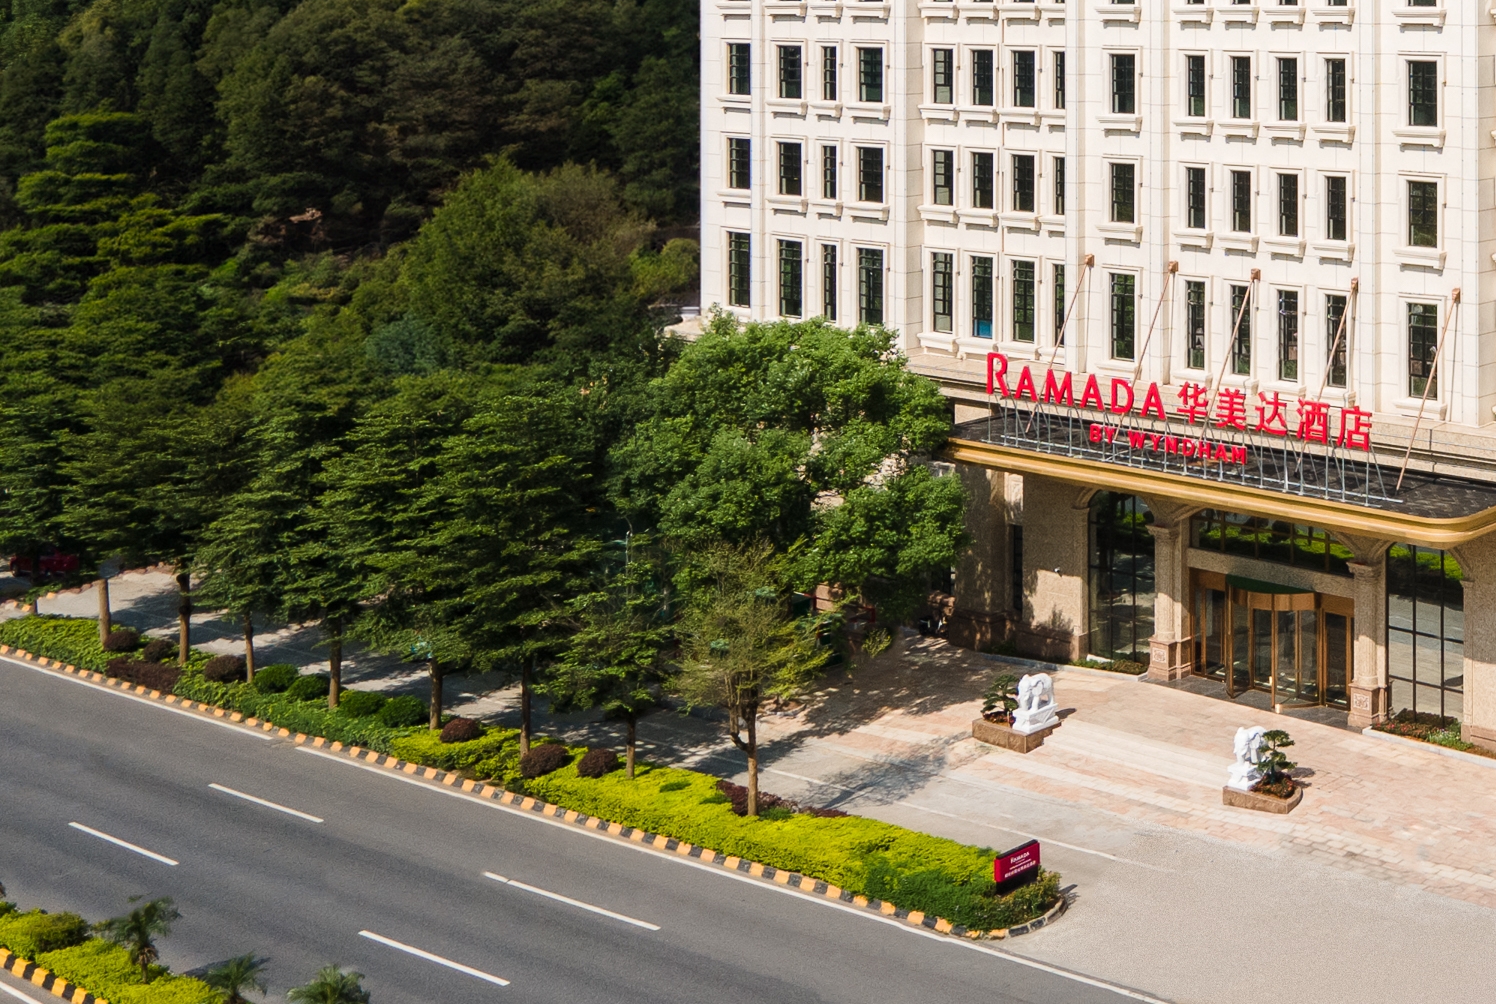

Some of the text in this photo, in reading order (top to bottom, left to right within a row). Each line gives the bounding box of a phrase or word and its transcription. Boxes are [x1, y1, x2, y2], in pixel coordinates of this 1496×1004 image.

[986, 351, 1373, 452] RAMADA 华美达酒店
[1089, 423, 1248, 465] BY WYNDHAM
